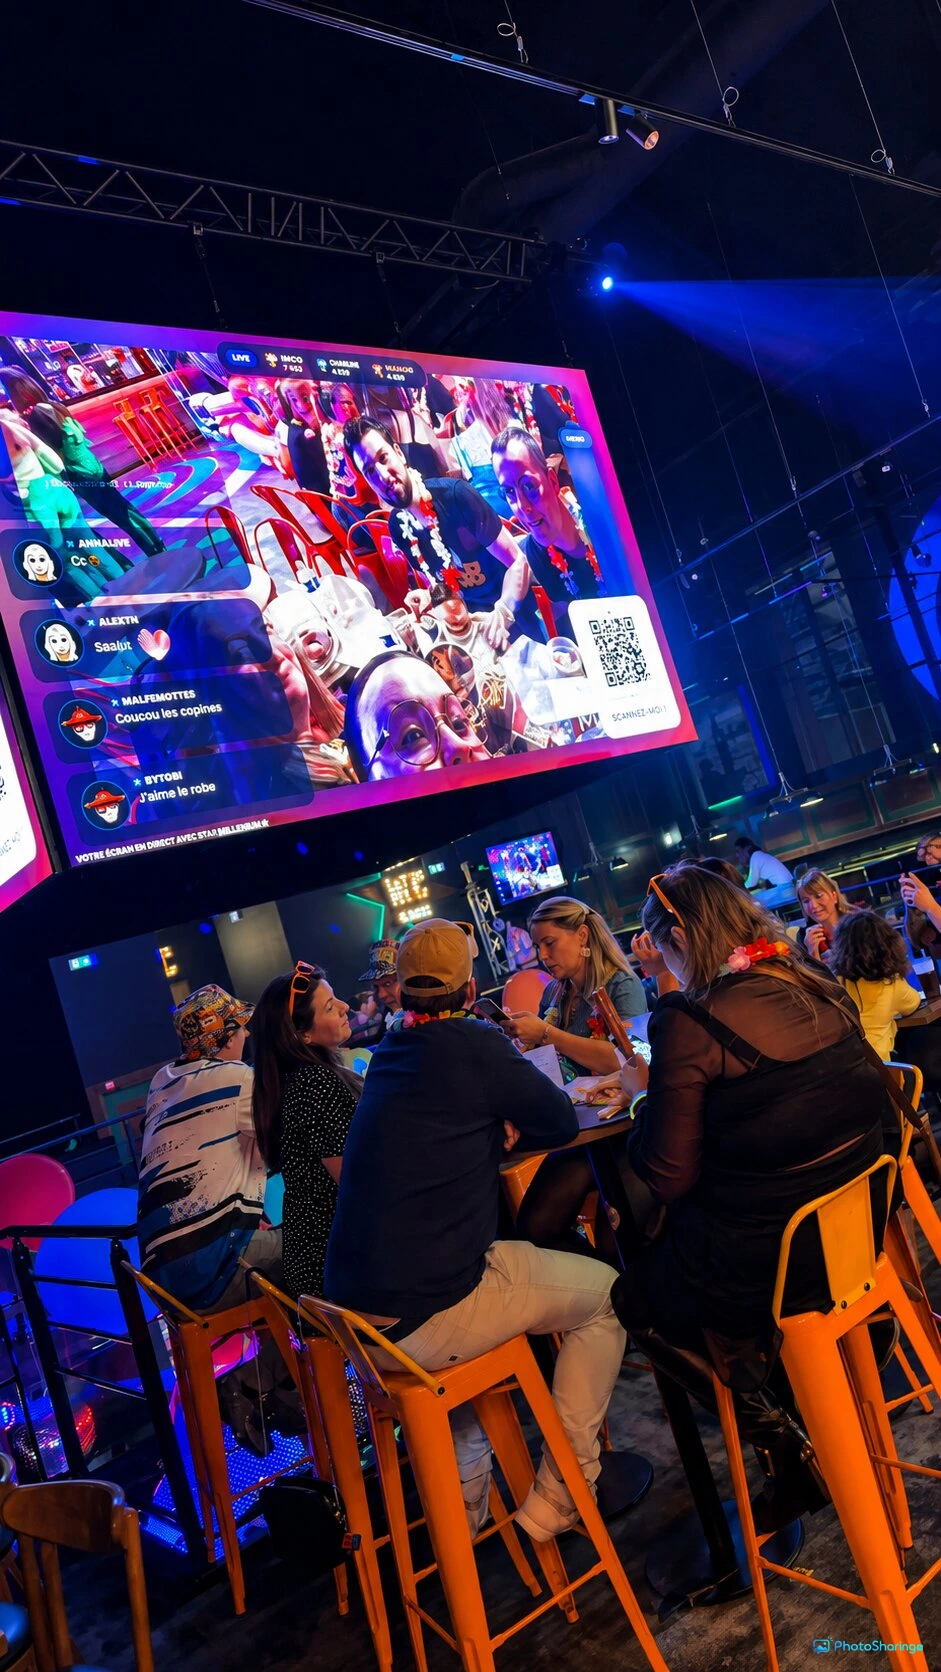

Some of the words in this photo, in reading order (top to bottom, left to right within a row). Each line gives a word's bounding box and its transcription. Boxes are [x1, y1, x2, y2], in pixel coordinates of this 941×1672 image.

[231, 353, 251, 363] LIVE
[79, 538, 131, 548] ANNALIVE
[70, 555, 88, 567] Cc
[94, 640, 133, 653] Saalut
[121, 689, 196, 706] MALFEMOTTES
[115, 710, 160, 724] Coucou
[161, 706, 179, 719] les
[180, 703, 222, 717] copines
[144, 771, 183, 785] BYTOBI
[139, 789, 176, 803] J'aime
[177, 785, 189, 797] le
[190, 782, 216, 795] robe
[75, 850, 105, 863] VOTRE
[105, 844, 135, 858] ÉCRAN
[134, 843, 147, 853] EN
[147, 837, 175, 850] DIRECT
[176, 832, 198, 844] AVEC
